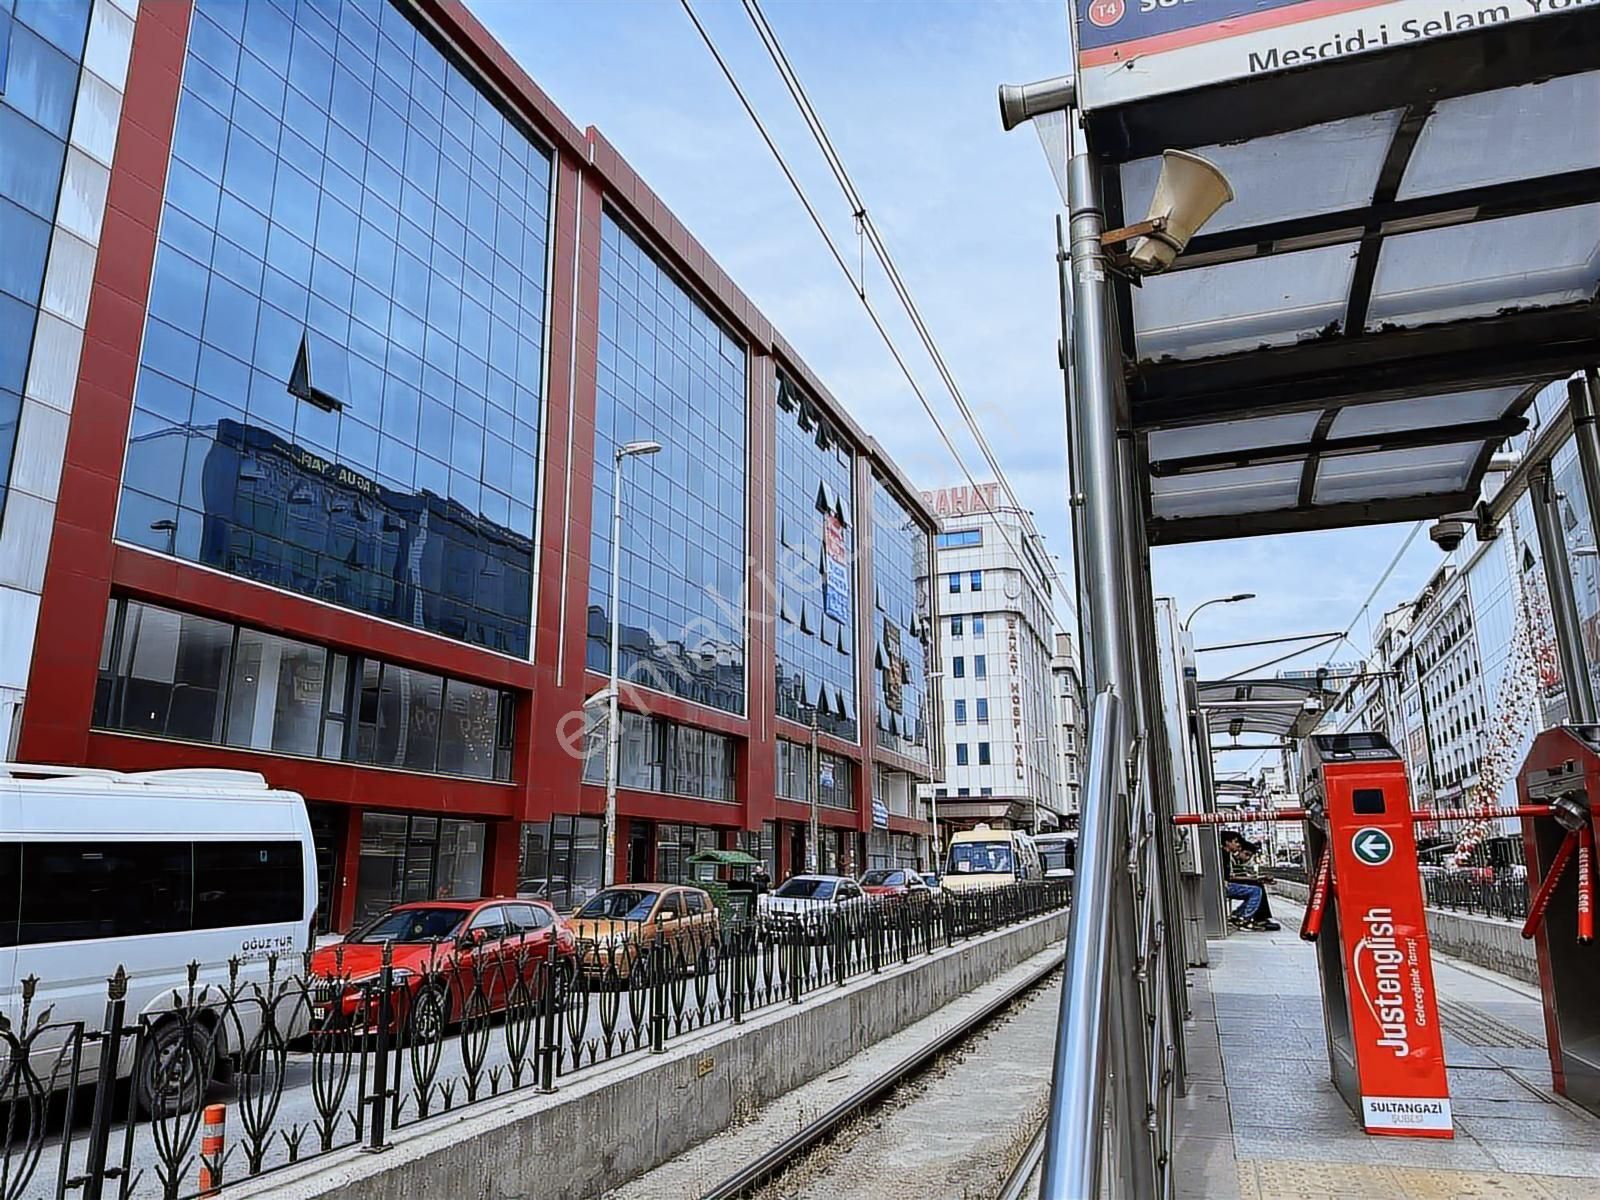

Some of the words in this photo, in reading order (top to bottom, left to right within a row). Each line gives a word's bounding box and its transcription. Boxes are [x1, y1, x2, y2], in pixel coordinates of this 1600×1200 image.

[1097, 2, 1117, 17] T4
[1248, 24, 1388, 73] Mescid-i
[1401, 5, 1510, 41] Selam
[1011, 683, 1024, 780] HOSPITAL
[1362, 907, 1410, 1058] Justenglish
[1370, 1102, 1443, 1114] SULTANGAZİ
